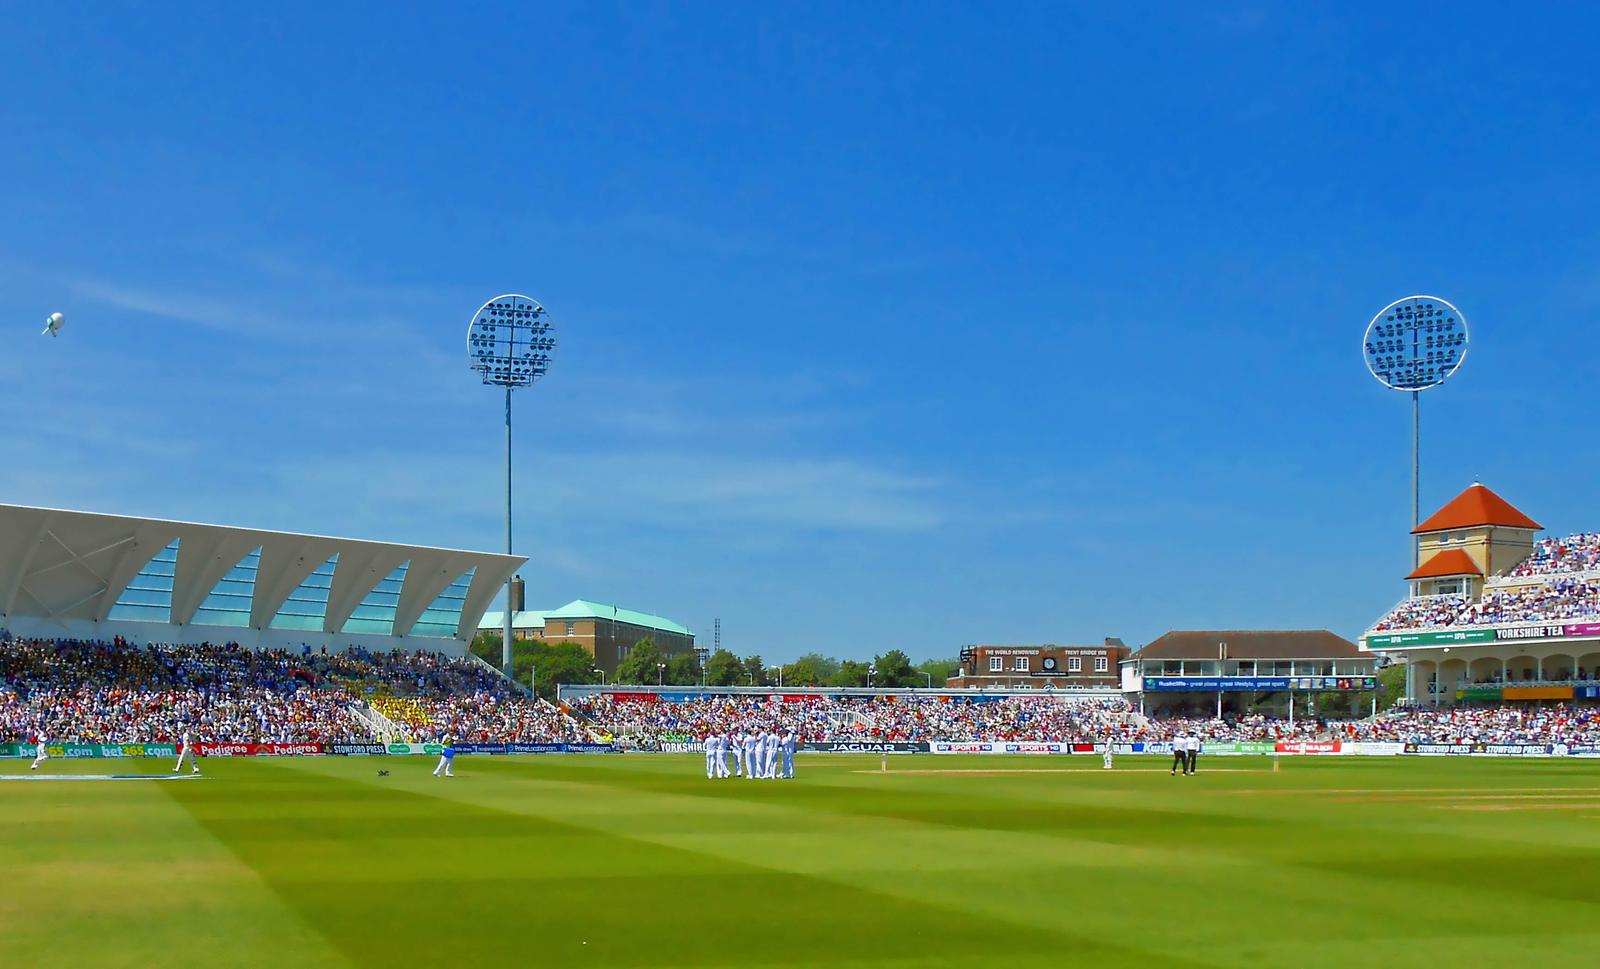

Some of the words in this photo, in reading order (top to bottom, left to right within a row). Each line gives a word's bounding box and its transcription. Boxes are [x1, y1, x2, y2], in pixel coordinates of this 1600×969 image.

[1496, 626, 1545, 639] YORKSHIRE
[1546, 625, 1564, 636] TEA
[18, 745, 93, 757] be65.com
[101, 745, 173, 756] bet365.com
[201, 744, 248, 755] Pedigree
[273, 744, 318, 755] Pedigree
[333, 744, 366, 754] STOWFORD
[366, 745, 385, 754] PRESS
[828, 743, 895, 751] JAGUAR
[1143, 742, 1174, 753] Kwik
[1416, 745, 1450, 753] STOWFORD
[1449, 745, 1471, 753] PRESS
[1485, 745, 1523, 754] STOWFORD
[1522, 745, 1546, 754] PRESS
